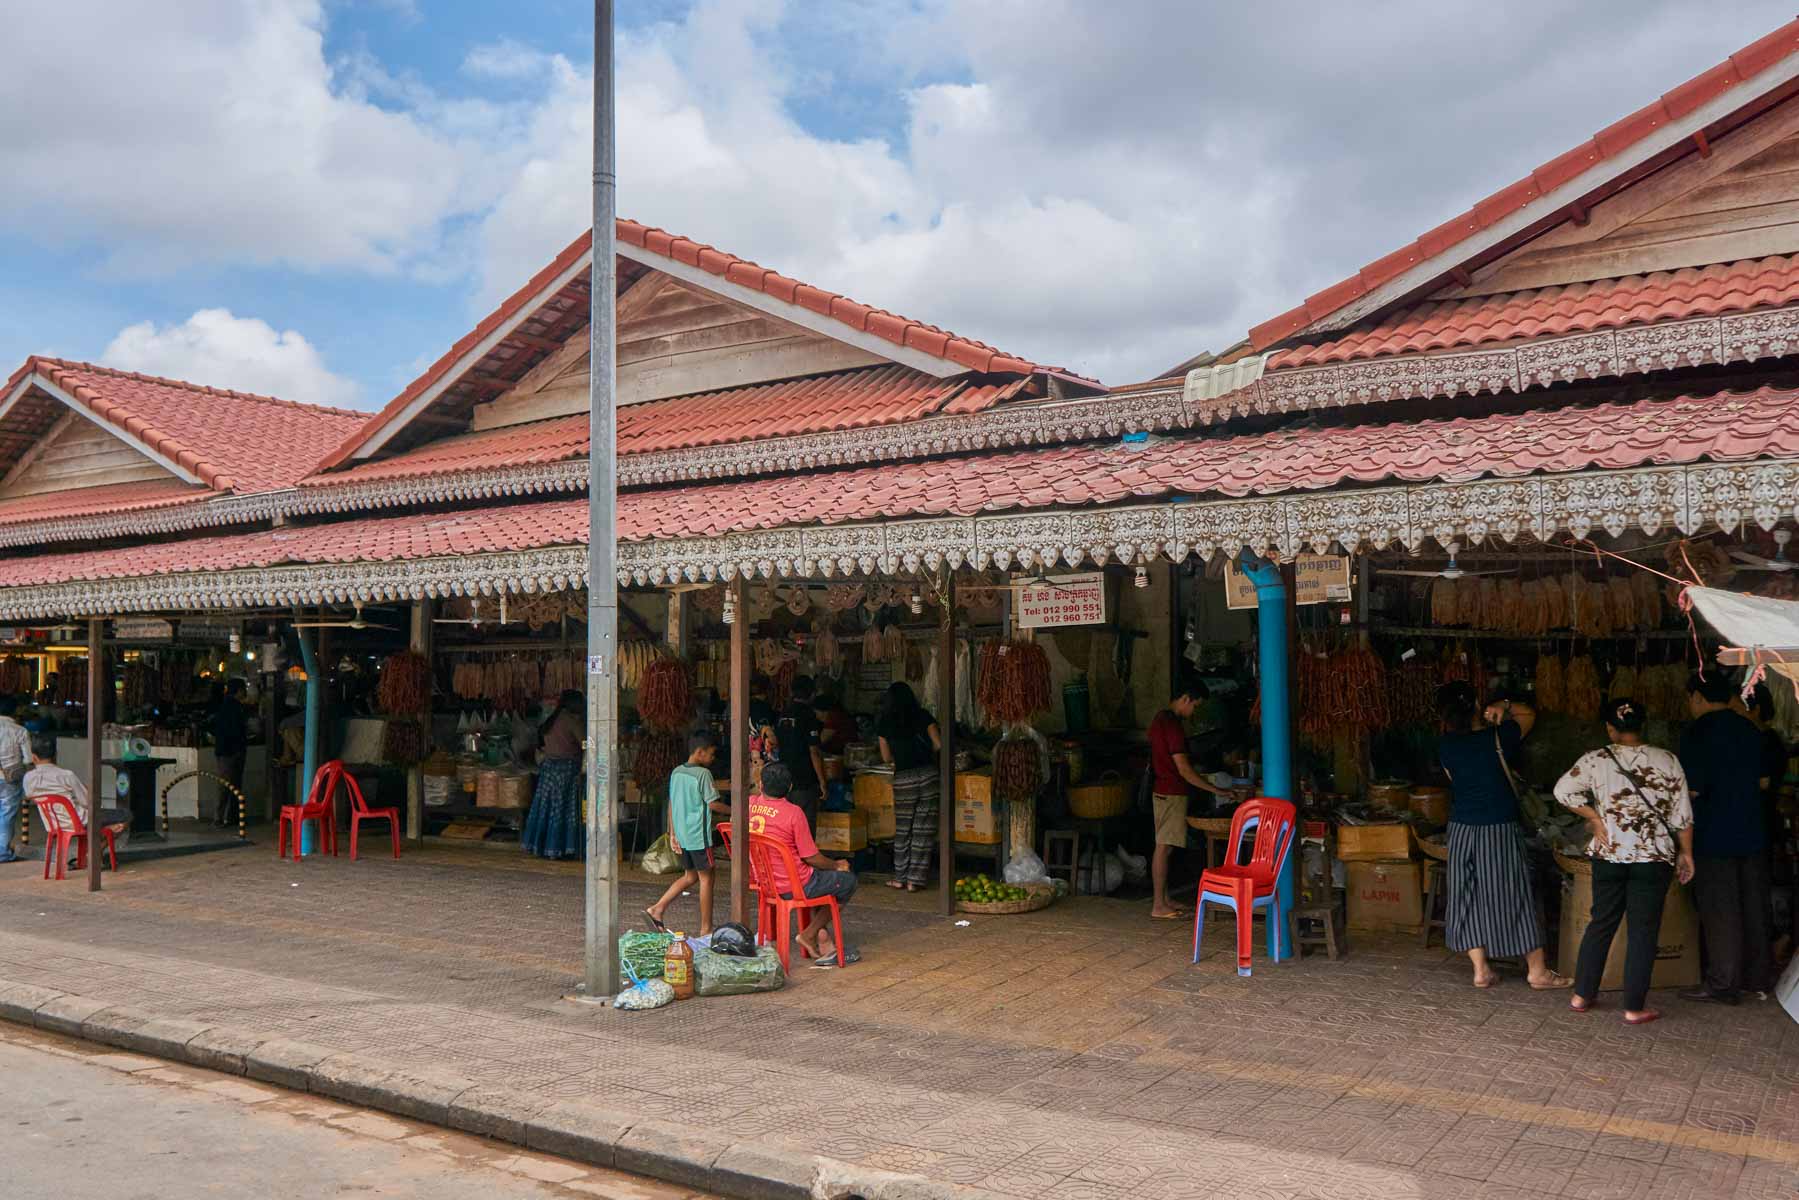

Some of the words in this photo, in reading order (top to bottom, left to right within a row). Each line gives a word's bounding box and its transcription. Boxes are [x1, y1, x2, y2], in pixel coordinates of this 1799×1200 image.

[1024, 608, 1041, 616] Tel:
[1043, 606, 1060, 615] 012
[1062, 604, 1080, 613] 990
[1082, 603, 1100, 611] 551
[1043, 615, 1061, 623] 012
[1063, 614, 1080, 622] 960
[1082, 612, 1100, 621] 751
[749, 804, 779, 818] ORRES
